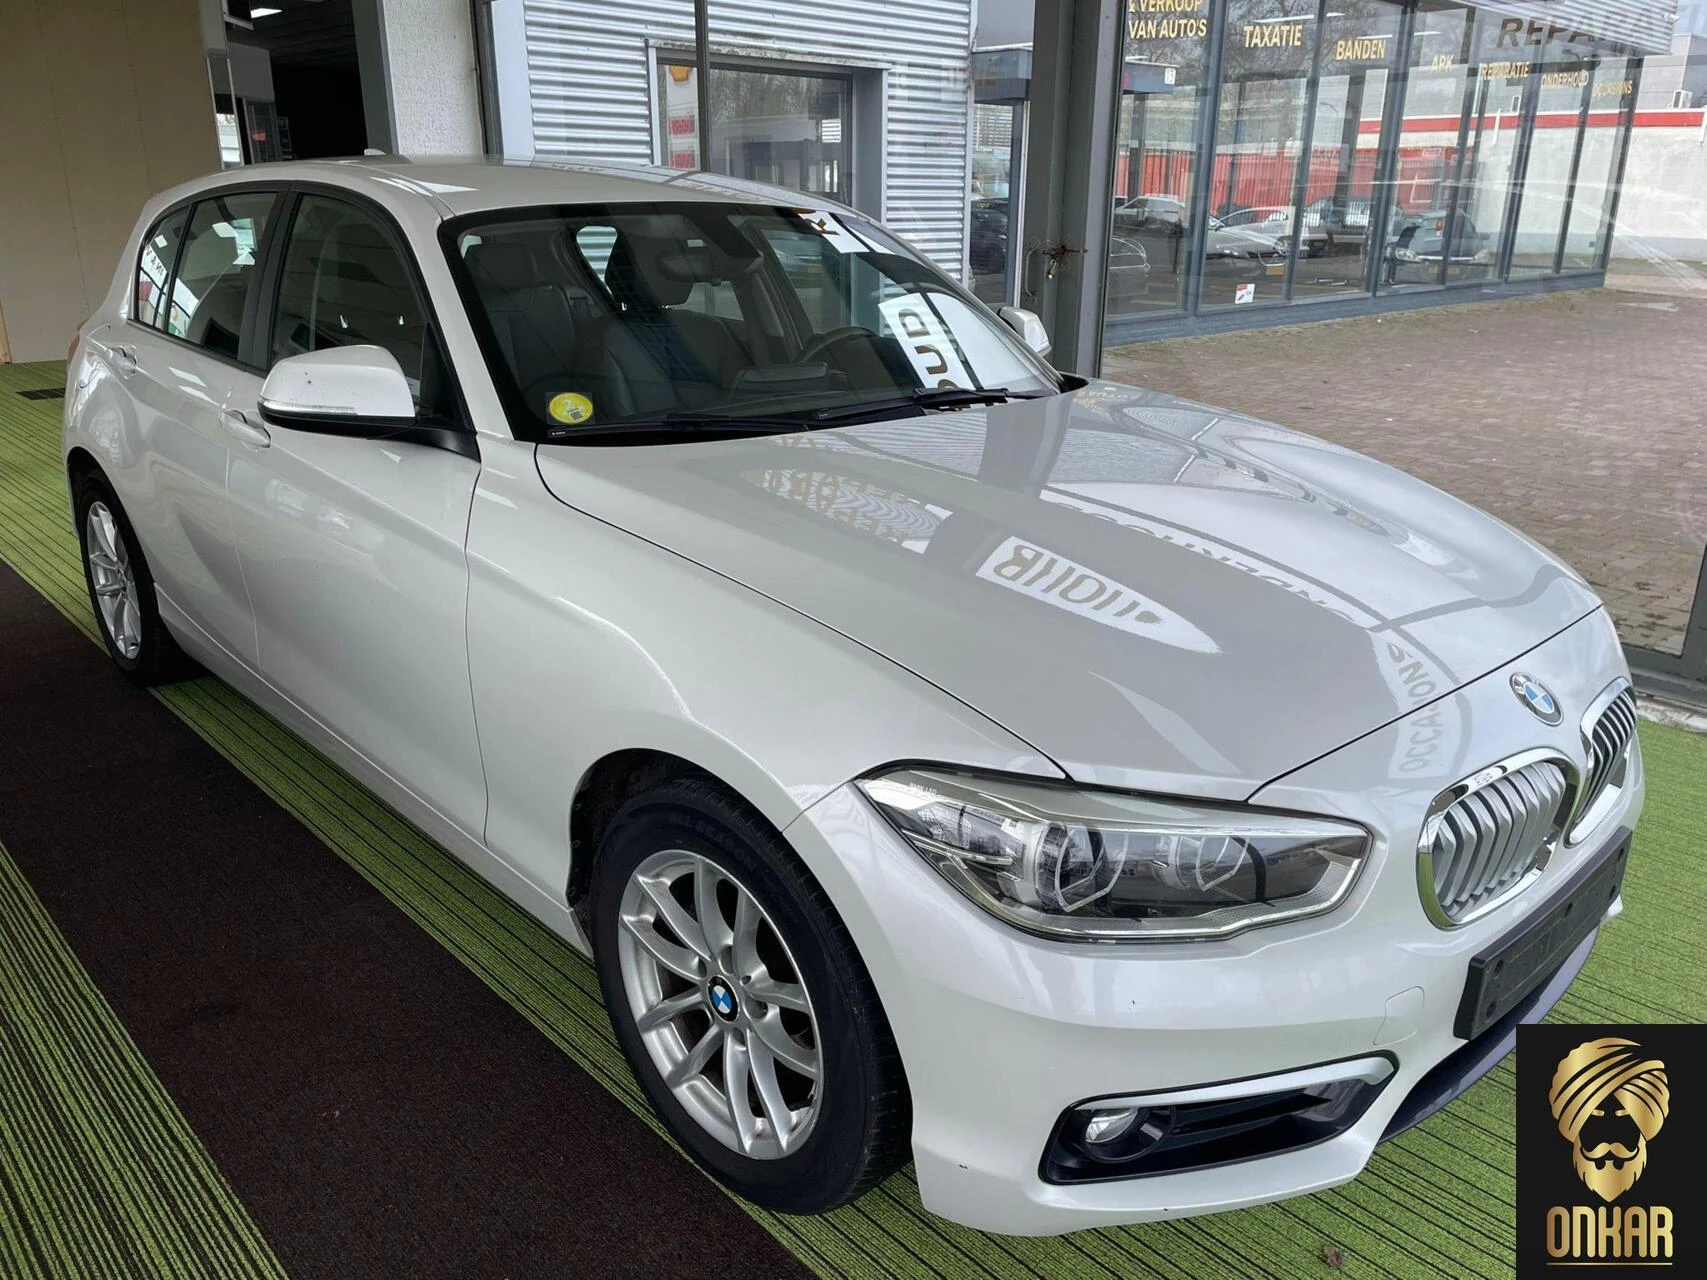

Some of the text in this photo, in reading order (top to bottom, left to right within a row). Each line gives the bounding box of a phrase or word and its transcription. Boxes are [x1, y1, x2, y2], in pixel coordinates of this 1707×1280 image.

[1128, 18, 1207, 39] VAN AUTO'S
[1243, 24, 1303, 48] TAXATIE
[1335, 39, 1387, 61] BANDEN
[1431, 54, 1454, 73] APK
